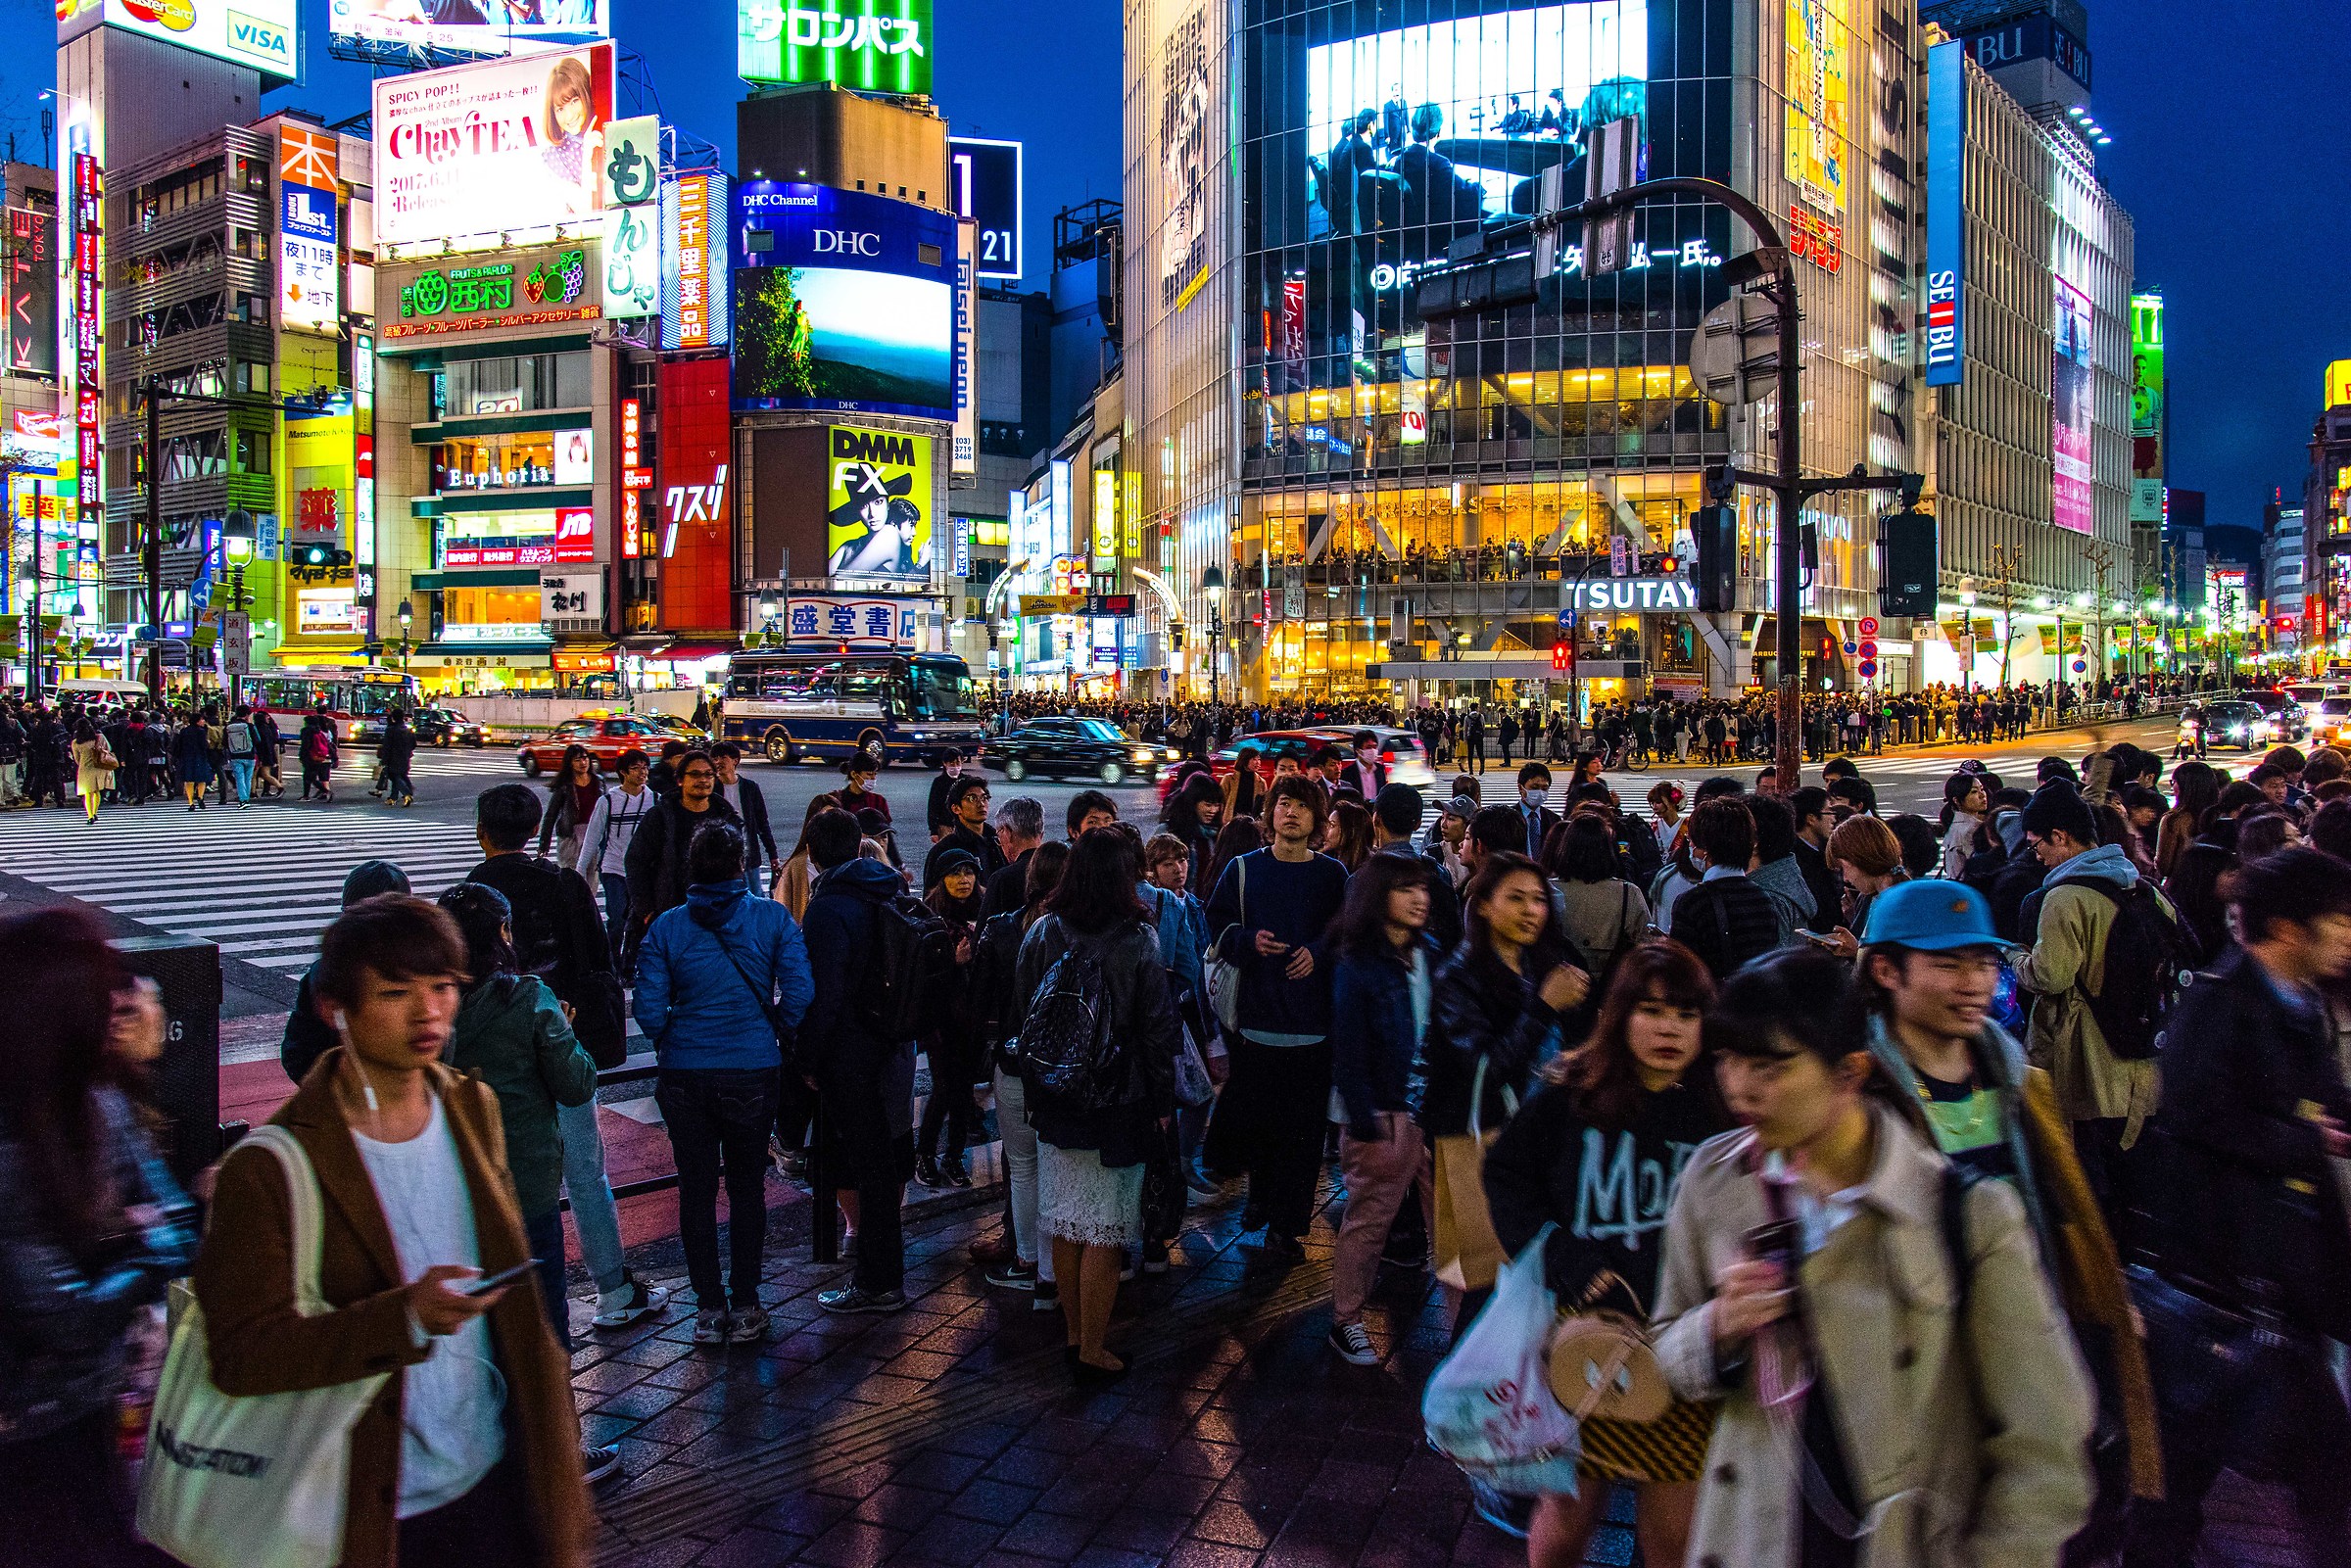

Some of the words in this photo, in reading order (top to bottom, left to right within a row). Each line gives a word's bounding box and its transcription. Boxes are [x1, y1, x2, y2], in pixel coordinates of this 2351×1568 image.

[235, 24, 286, 54] VISA
[748, 6, 924, 57] サロンパス
[389, 90, 421, 105] SPICY
[425, 83, 459, 98] POP!!
[743, 195, 768, 207] DHC
[770, 194, 818, 207] Channel
[33, 214, 45, 262] TOKYO
[607, 139, 656, 310] もんじゃ
[285, 241, 334, 266] 夜11時
[813, 229, 881, 257] DHC
[983, 230, 1011, 262] 21
[450, 263, 514, 280] FRUITS&PARLOR
[680, 182, 701, 337] 三千里薬品
[307, 290, 334, 308] 地下
[401, 286, 413, 318] 渋谷
[449, 278, 513, 313] 西村
[957, 252, 972, 334] Taisei
[1929, 269, 1955, 369] SEIBU
[839, 401, 858, 409] DHC
[288, 430, 330, 439] Matsumoto
[834, 429, 916, 467] DMM
[955, 437, 971, 446] (03)
[449, 466, 551, 490] Euphoria
[833, 461, 888, 496] FX
[300, 488, 339, 531] 薬
[663, 464, 728, 557] クスリ
[1335, 496, 1483, 521] STARBUCKS
[265, 517, 275, 559] 渋谷駅前
[558, 512, 593, 540] JTB
[1565, 581, 1699, 609] TSUTAY
[228, 618, 240, 670] 道玄坂
